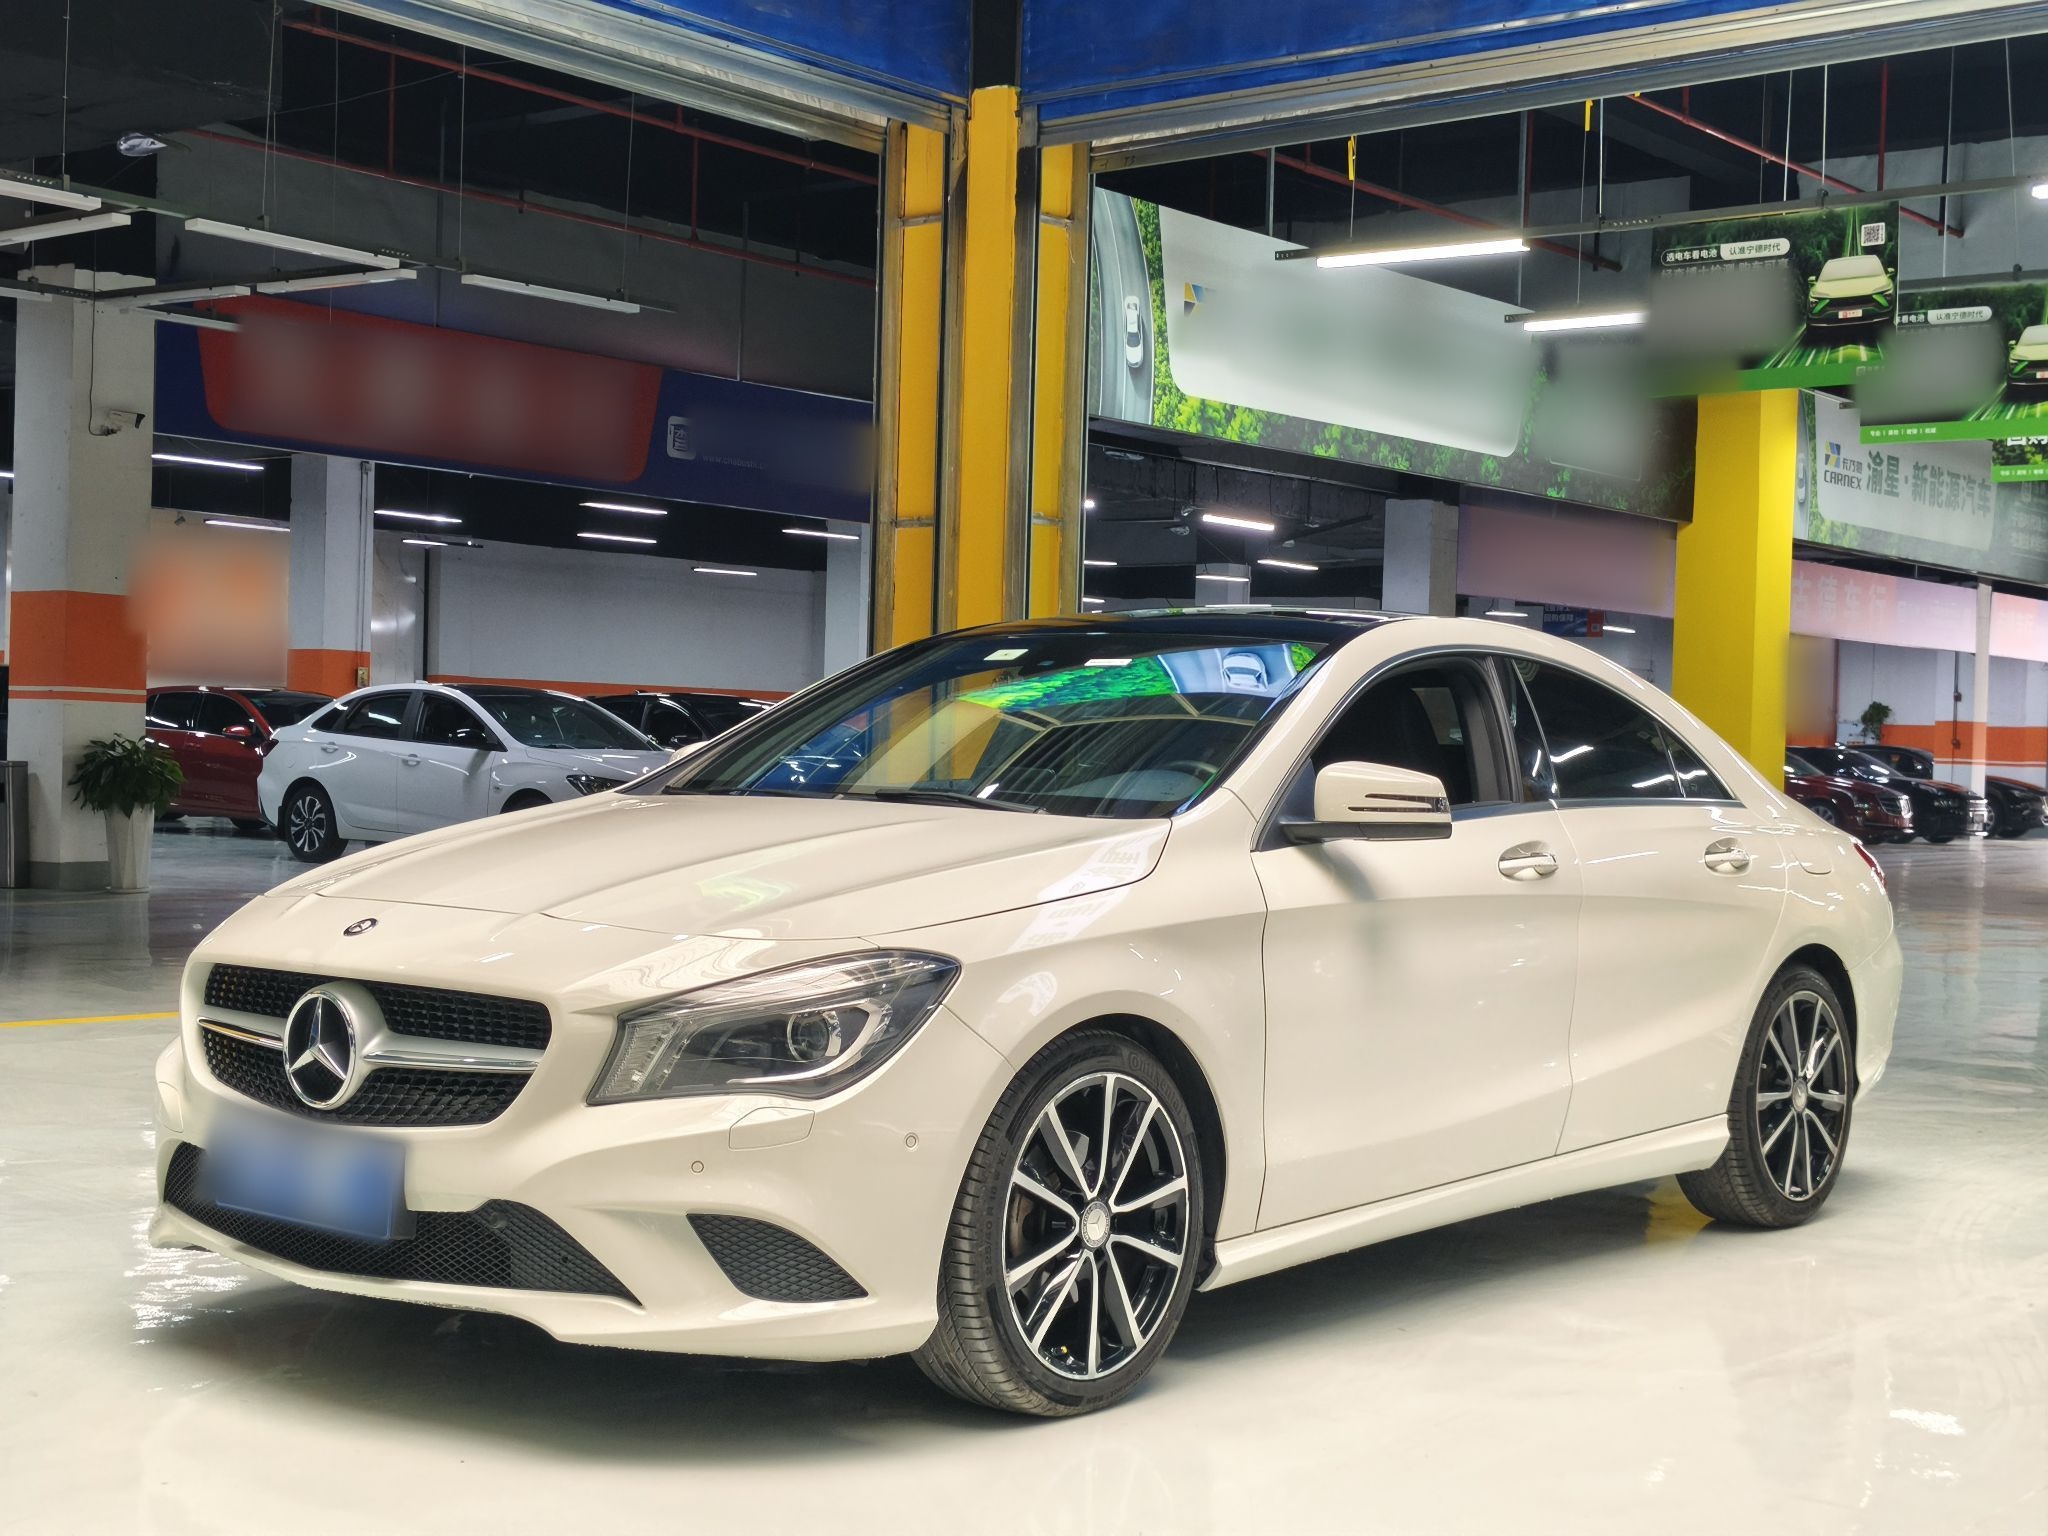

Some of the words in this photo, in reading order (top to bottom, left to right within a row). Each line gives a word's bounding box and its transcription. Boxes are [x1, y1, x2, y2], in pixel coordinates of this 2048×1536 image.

[1666, 247, 1718, 262] 选电车看电池
[1729, 242, 1781, 256] 认准宁德时代
[1823, 470, 1862, 490] CARNEX
